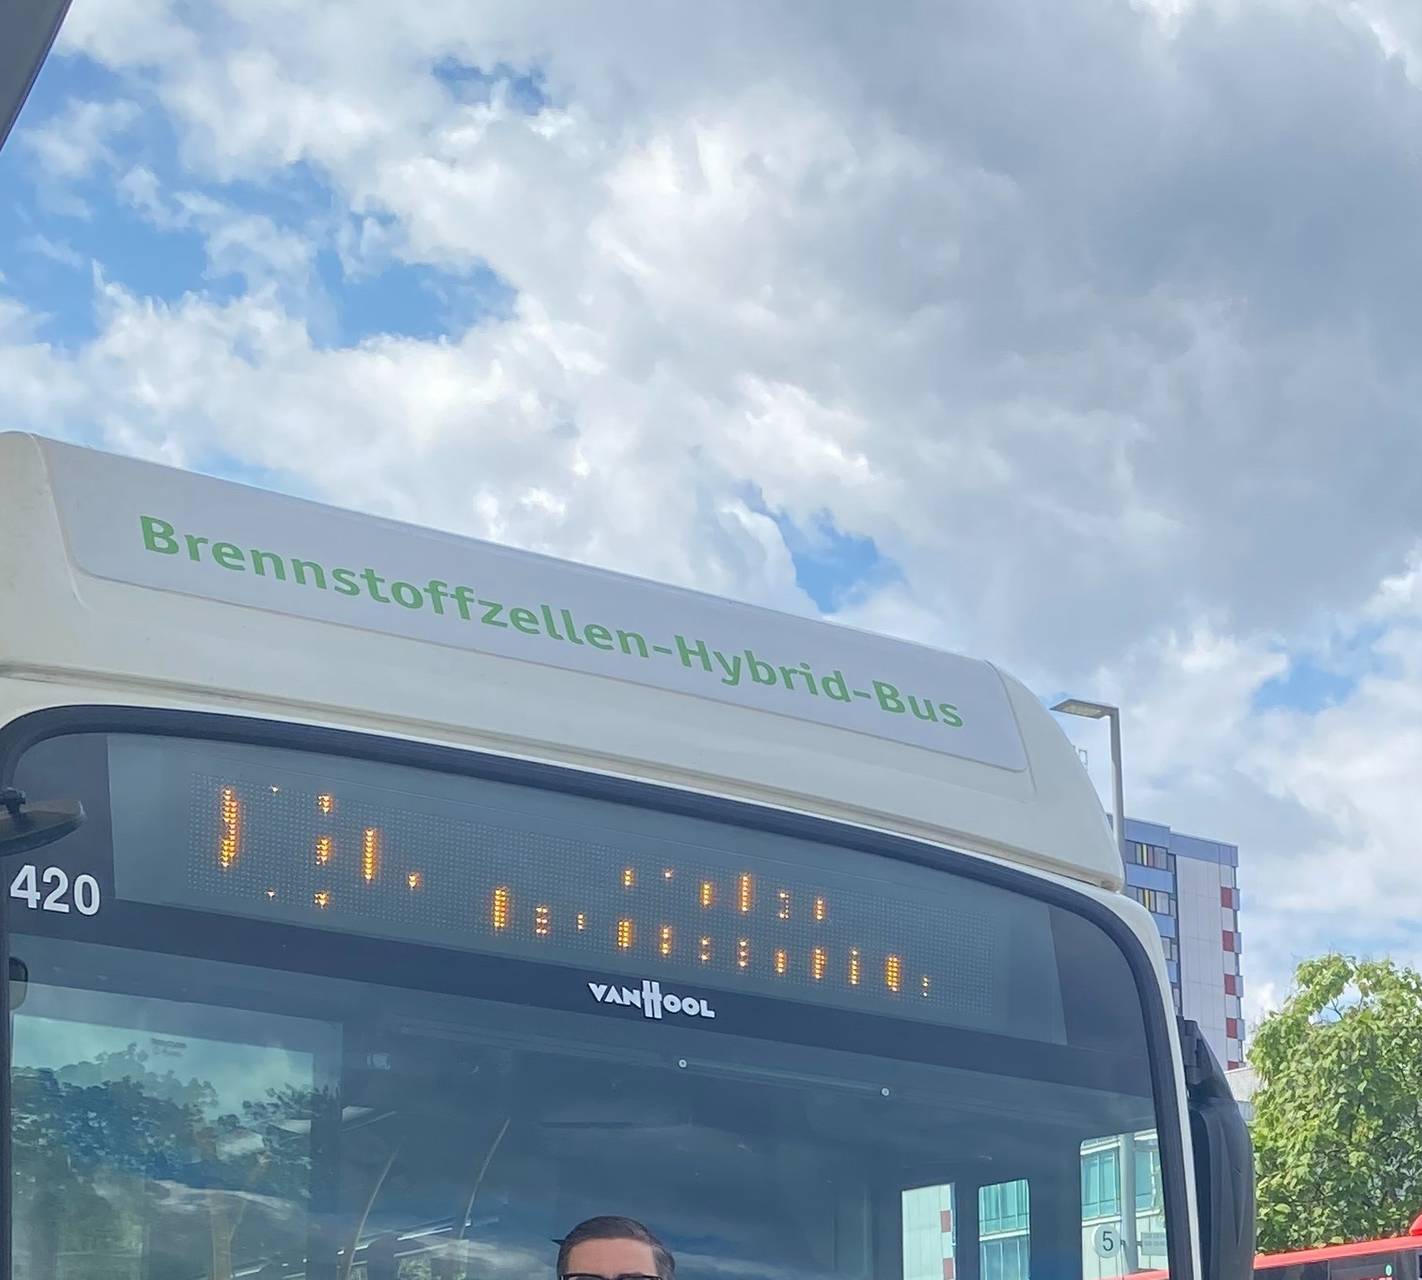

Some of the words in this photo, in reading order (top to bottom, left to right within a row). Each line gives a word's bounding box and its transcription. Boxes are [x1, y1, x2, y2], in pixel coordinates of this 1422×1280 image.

[140, 515, 964, 729] Brennstoffzellen-Hybrid-Bus
[10, 864, 100, 916] 420
[1102, 1231, 1113, 1251] 5
